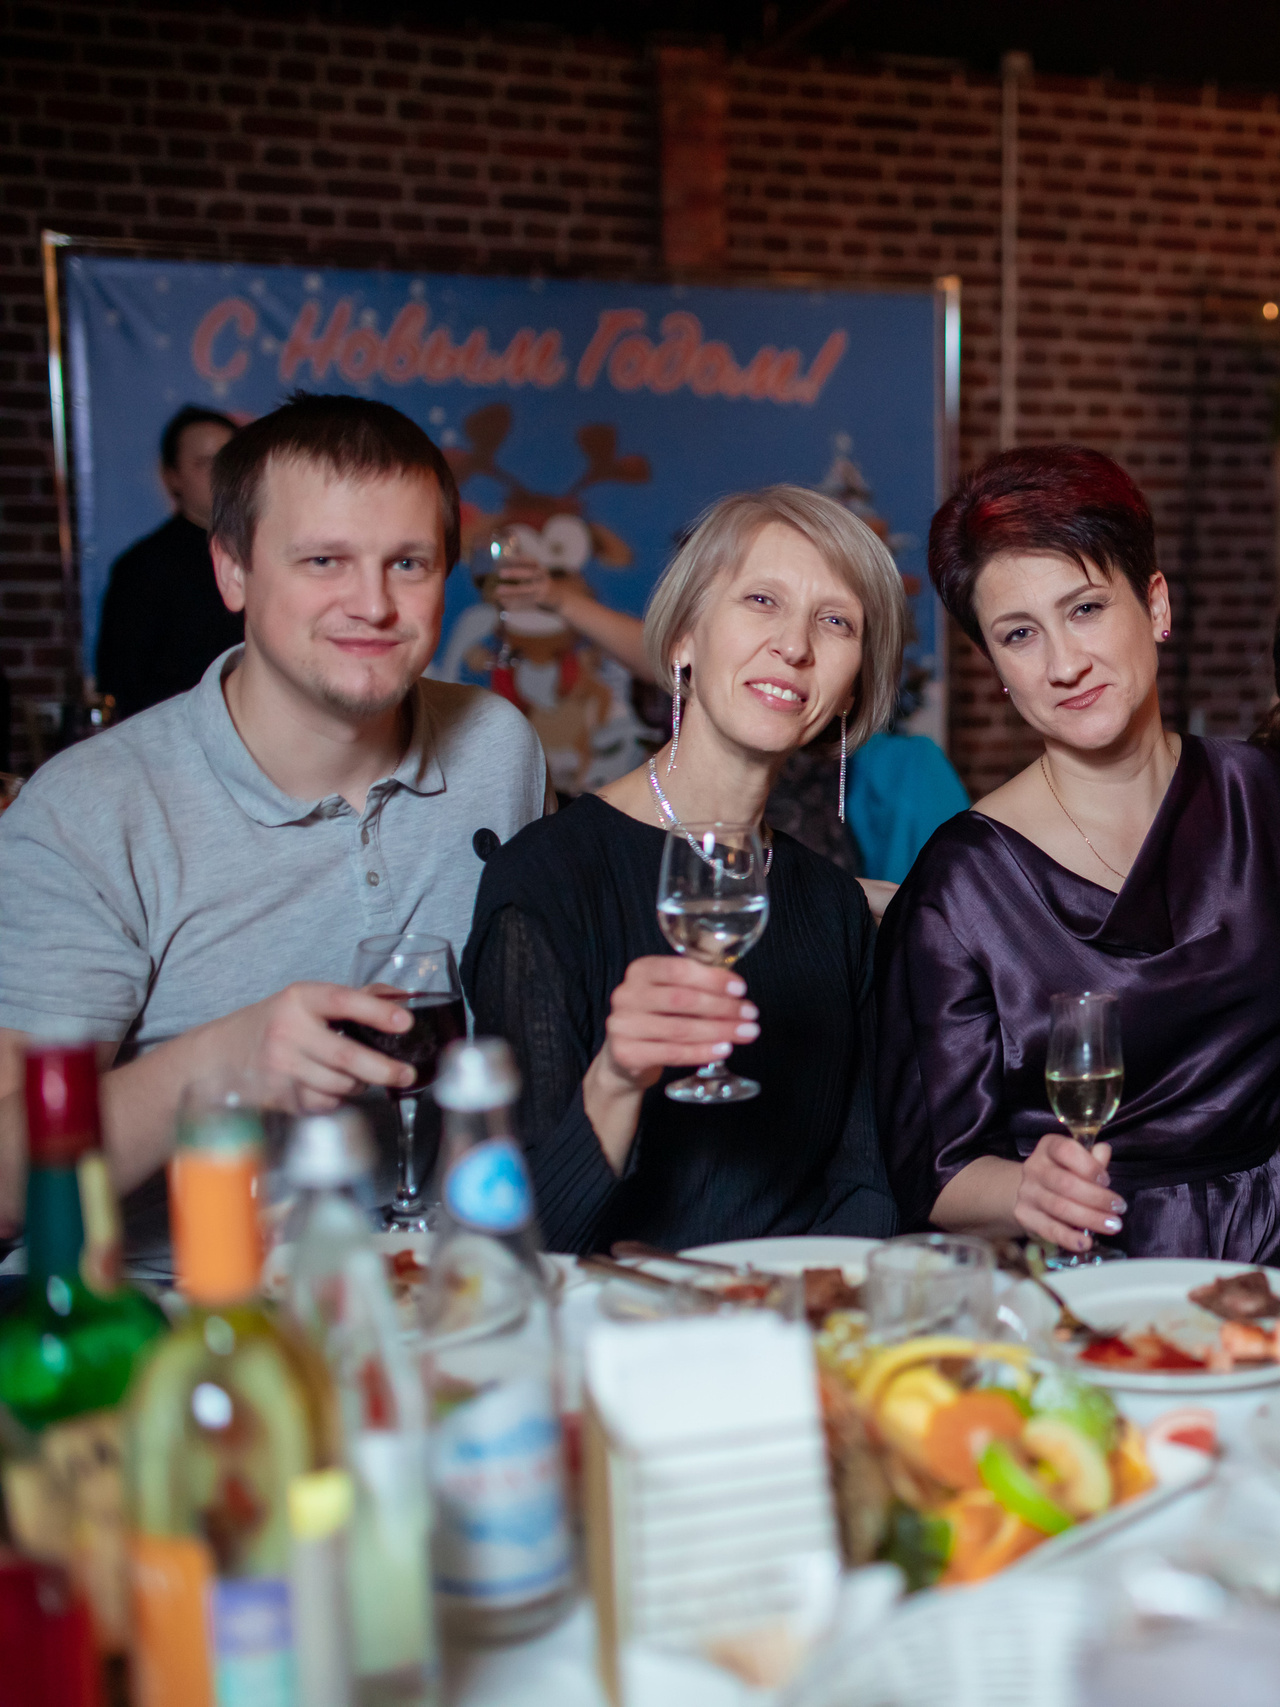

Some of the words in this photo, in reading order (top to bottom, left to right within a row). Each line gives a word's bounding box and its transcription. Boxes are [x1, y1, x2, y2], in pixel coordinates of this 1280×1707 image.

[192, 298, 257, 381] С
[277, 298, 567, 388] Новым
[576, 308, 848, 407] Годом!
